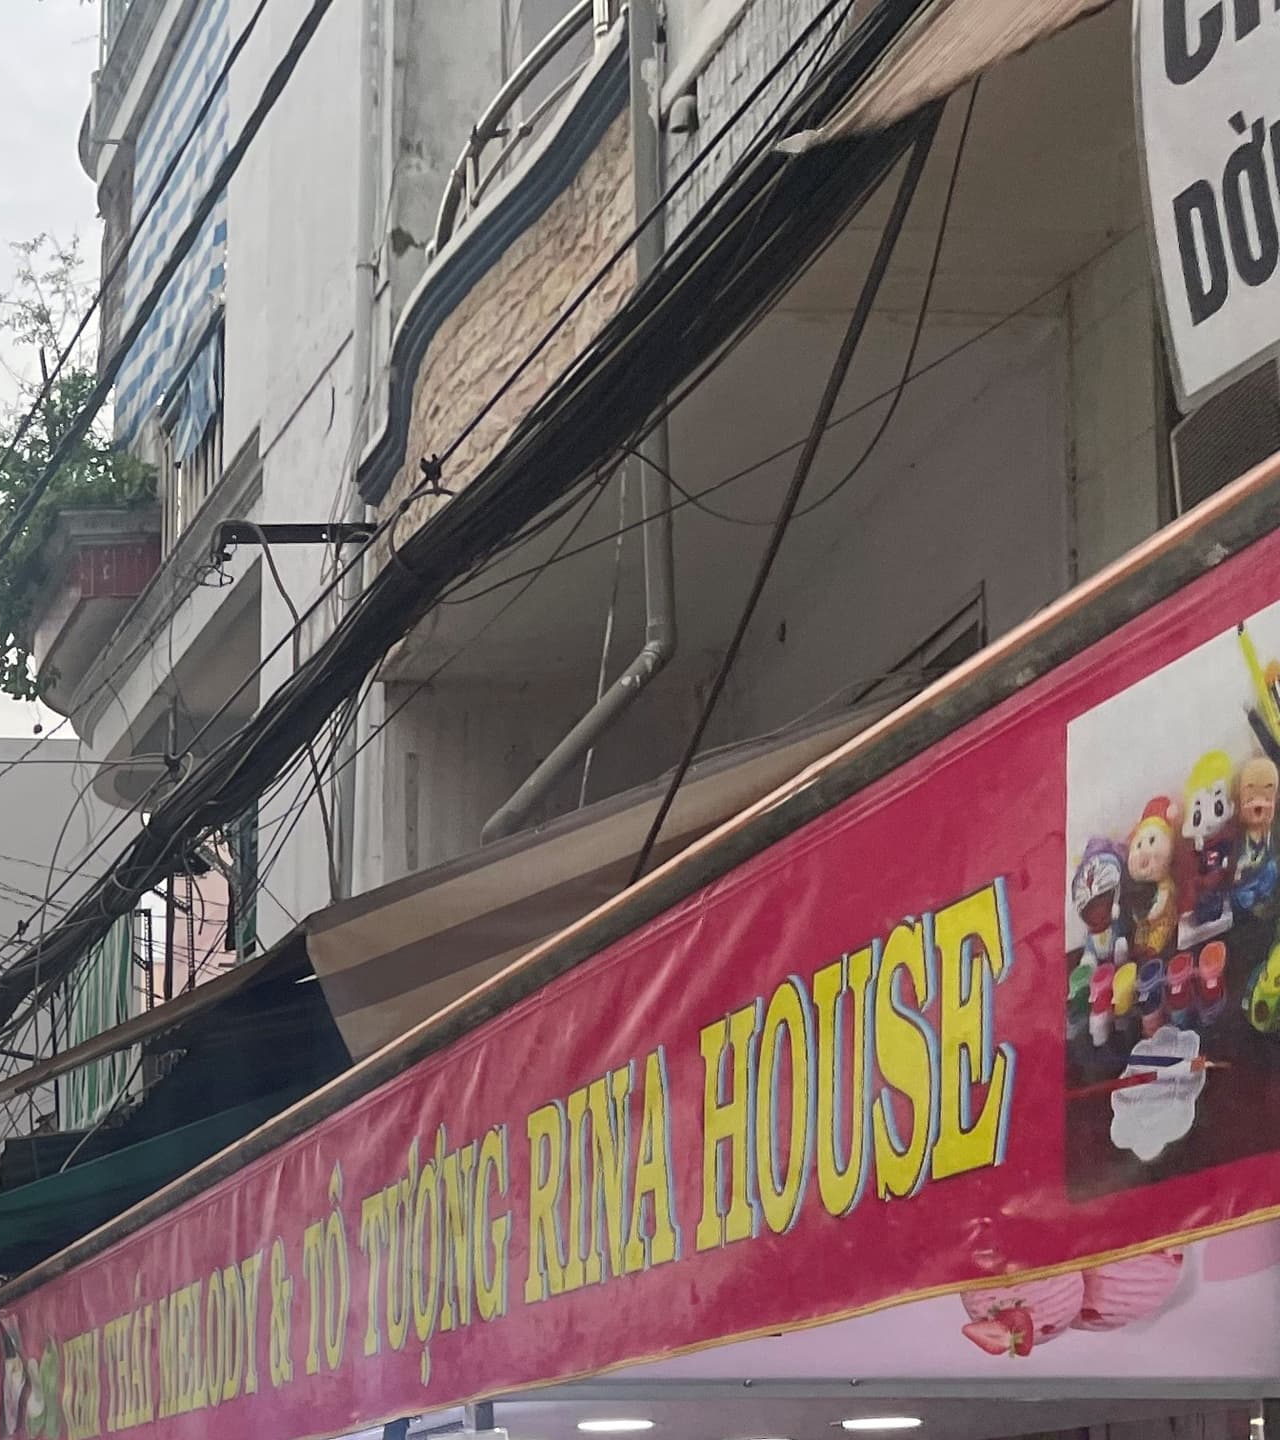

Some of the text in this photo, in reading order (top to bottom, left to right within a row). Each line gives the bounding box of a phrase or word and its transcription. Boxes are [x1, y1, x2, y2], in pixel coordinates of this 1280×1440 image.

[1173, 110, 1280, 327] DỜ
[158, 1248, 263, 1420] MELODY
[269, 1235, 294, 1389] &
[303, 1160, 351, 1375] TÔ
[361, 1124, 511, 1388] TƯỢNG
[523, 1045, 680, 1304] RINA
[695, 875, 1017, 1252] HOUSE
